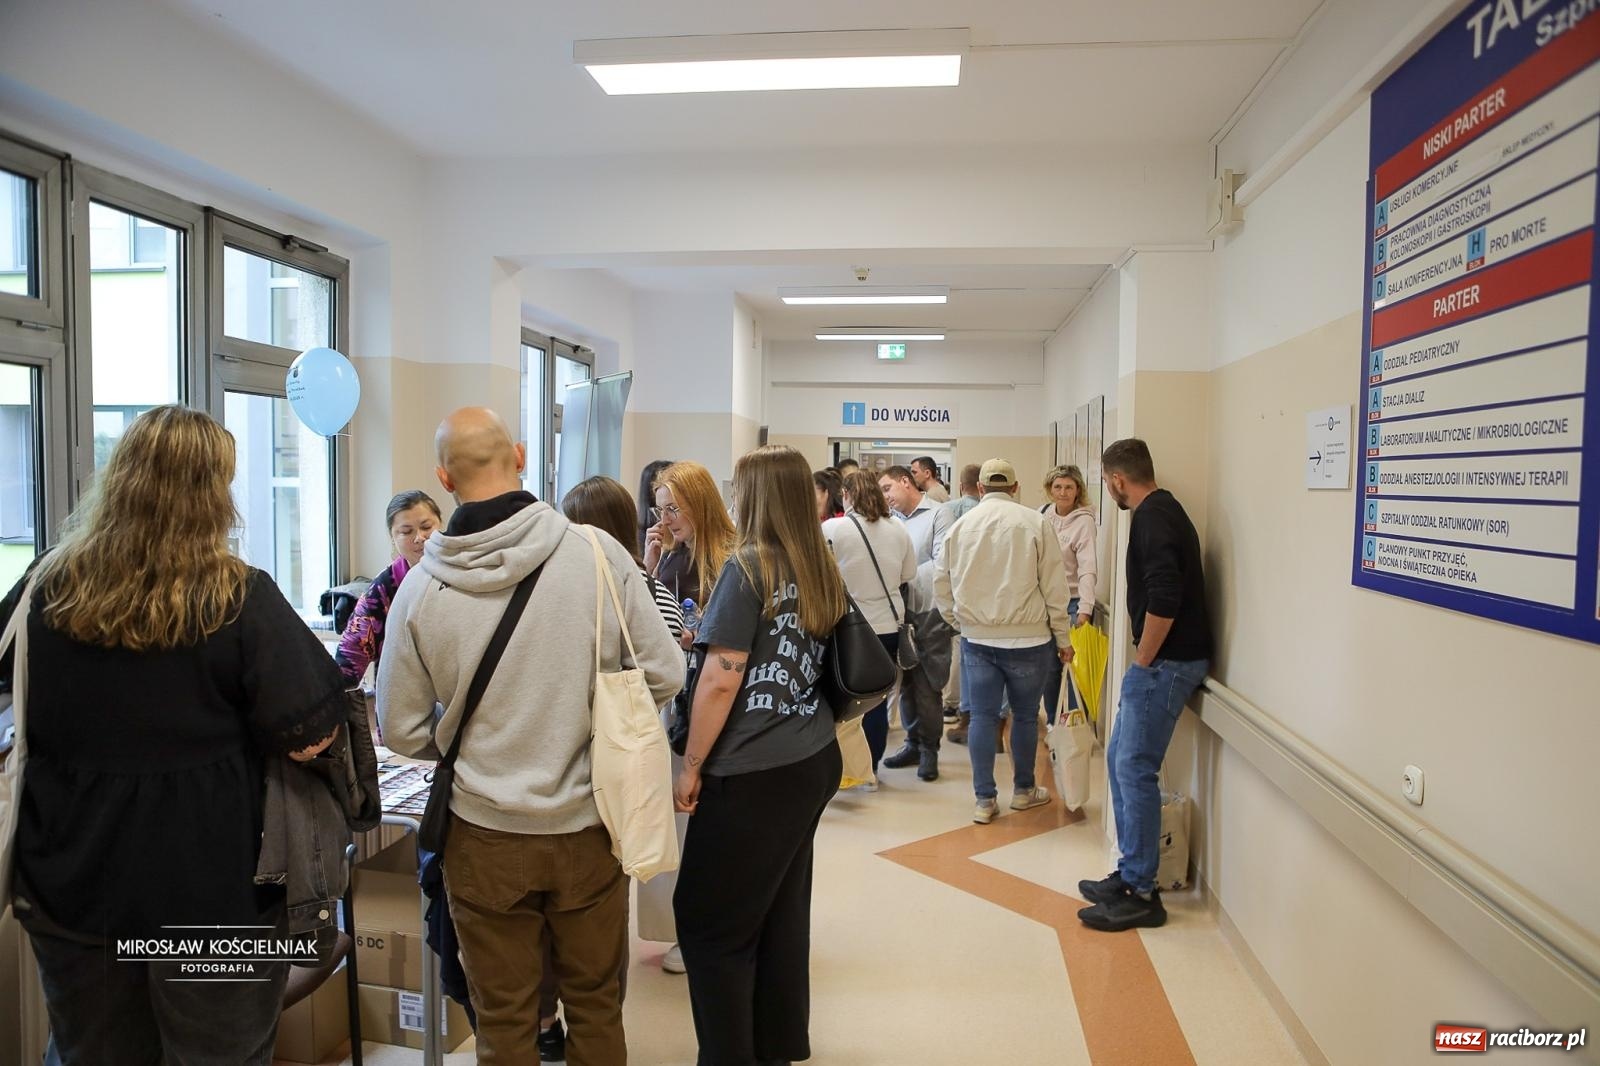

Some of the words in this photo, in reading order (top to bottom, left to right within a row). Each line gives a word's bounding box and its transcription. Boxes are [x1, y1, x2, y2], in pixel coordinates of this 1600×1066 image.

[1423, 125, 1451, 159] NISKI
[1454, 88, 1506, 139] PARTER
[1378, 206, 1385, 224] A
[1378, 244, 1385, 260] B
[1390, 217, 1427, 248] PRACOWNIA
[1428, 184, 1491, 229] DIAGNOSTYCZNA
[1390, 226, 1433, 262] KOLONOSKOPII
[1437, 200, 1491, 238] GASTROSKOPII
[1471, 232, 1481, 254] H
[1490, 234, 1508, 254] PRO
[1511, 217, 1547, 247] MORTE
[1388, 278, 1403, 296] SALA
[1404, 254, 1463, 289] KONFERENCYJNA
[1433, 284, 1480, 318] PARTER
[1373, 355, 1380, 371] A
[1384, 353, 1408, 371] ODDZIAŁ
[1409, 340, 1461, 365] PEDIATRYCZNY
[1372, 391, 1379, 408] A
[1382, 393, 1404, 408] STACJA
[1405, 390, 1425, 404] DIALIZ
[871, 408, 889, 421] DO
[894, 405, 950, 422] WYJŚCIA
[1371, 429, 1377, 445] B
[1380, 431, 1424, 446] LABORATORIUM
[1425, 427, 1471, 443] ANALITYCZNE
[1477, 418, 1569, 439] MIKROBIOLOGICZNE
[1369, 466, 1376, 482] B
[1380, 473, 1403, 485] ODDZIAŁ
[1404, 472, 1460, 485] ANESTEZJOLOGII
[1465, 471, 1526, 486] INTENSYWNEJ
[1529, 470, 1569, 486] TERAPII
[1368, 503, 1374, 520] C
[1381, 512, 1410, 525] SZPITALNY
[1411, 514, 1437, 528] ODDZIAŁ
[1438, 517, 1485, 532] RATUNKOWY
[1486, 520, 1510, 537] (SOR)
[1366, 540, 1373, 557] C
[1378, 542, 1408, 556] PLANOWY
[1409, 547, 1431, 560] PUNKT
[1378, 555, 1399, 568] NOCNA
[1402, 559, 1446, 577] ŚWIĄTECZNA
[1447, 568, 1477, 583] OPIEKA
[777, 635, 798, 662] be
[745, 661, 789, 689] life
[745, 690, 773, 712] in
[366, 937, 385, 949] DC
